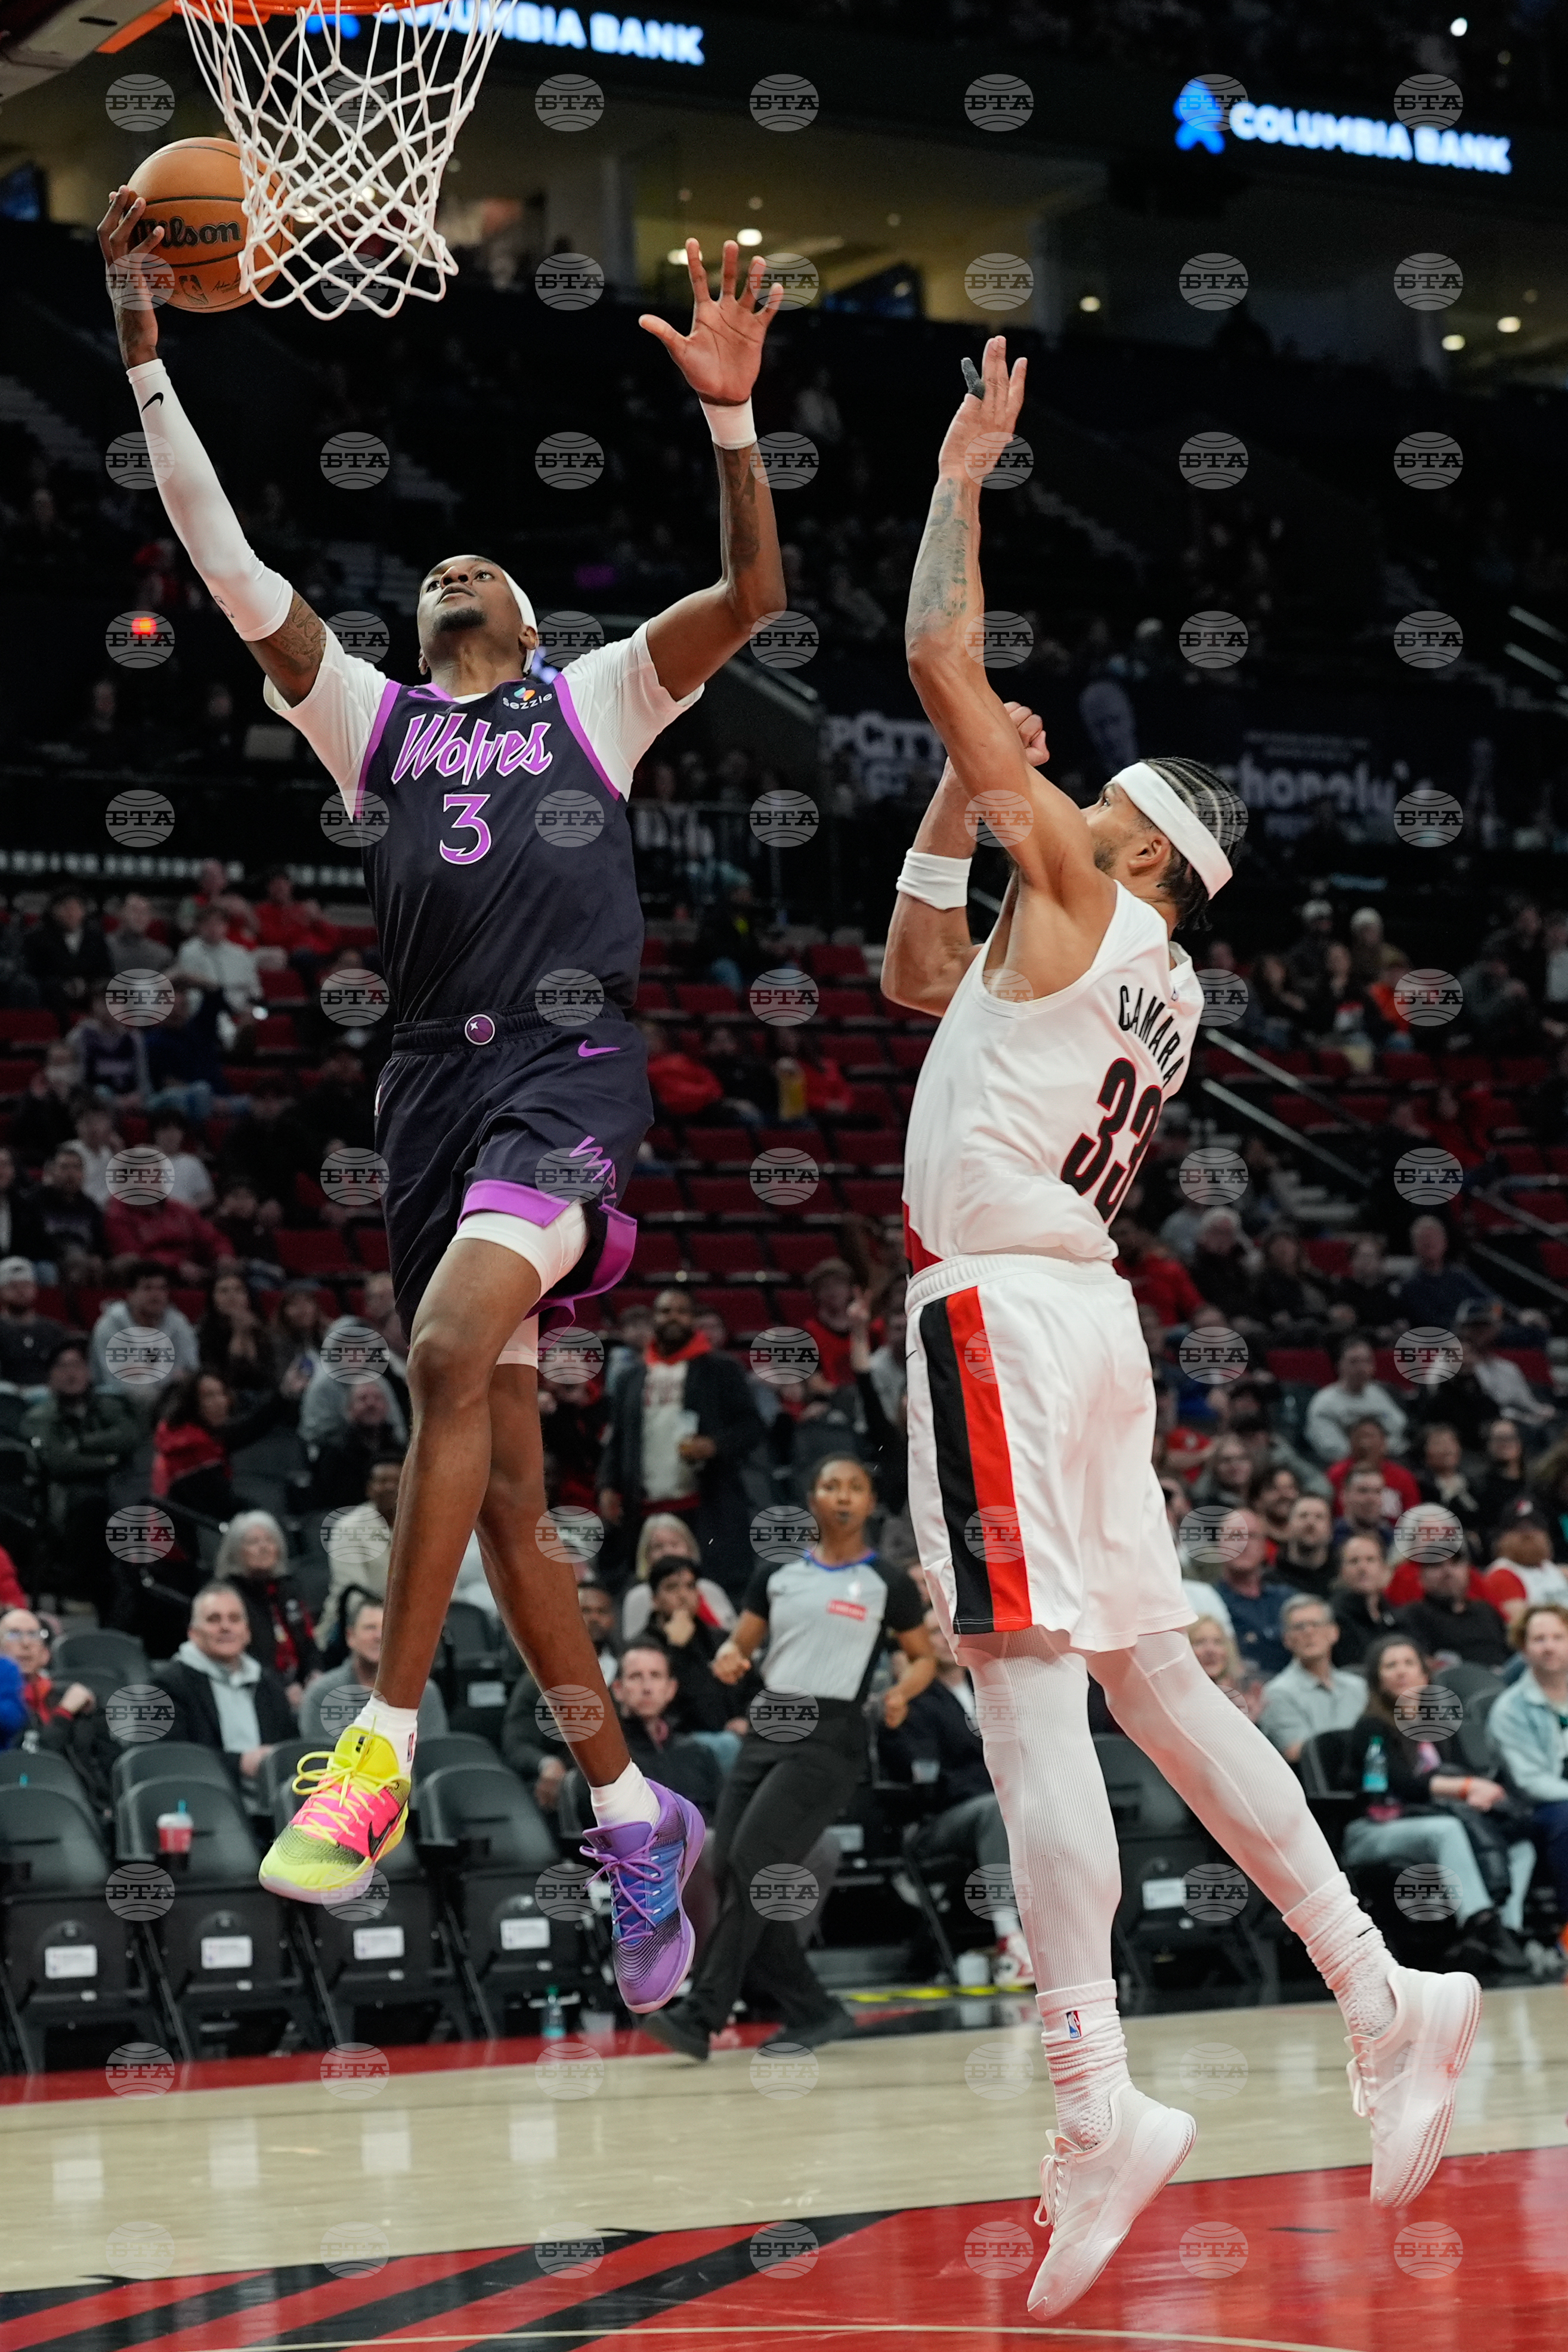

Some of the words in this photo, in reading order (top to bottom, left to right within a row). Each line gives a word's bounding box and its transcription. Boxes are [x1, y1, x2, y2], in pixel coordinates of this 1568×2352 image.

[590, 13, 705, 66] BANK
[1229, 101, 1414, 161] COLUMBIA
[1414, 126, 1511, 175] BANK
[502, 693, 553, 710] sezzle
[391, 713, 553, 786] Wolves
[439, 793, 492, 865] 3
[1060, 1057, 1164, 1223] 33
